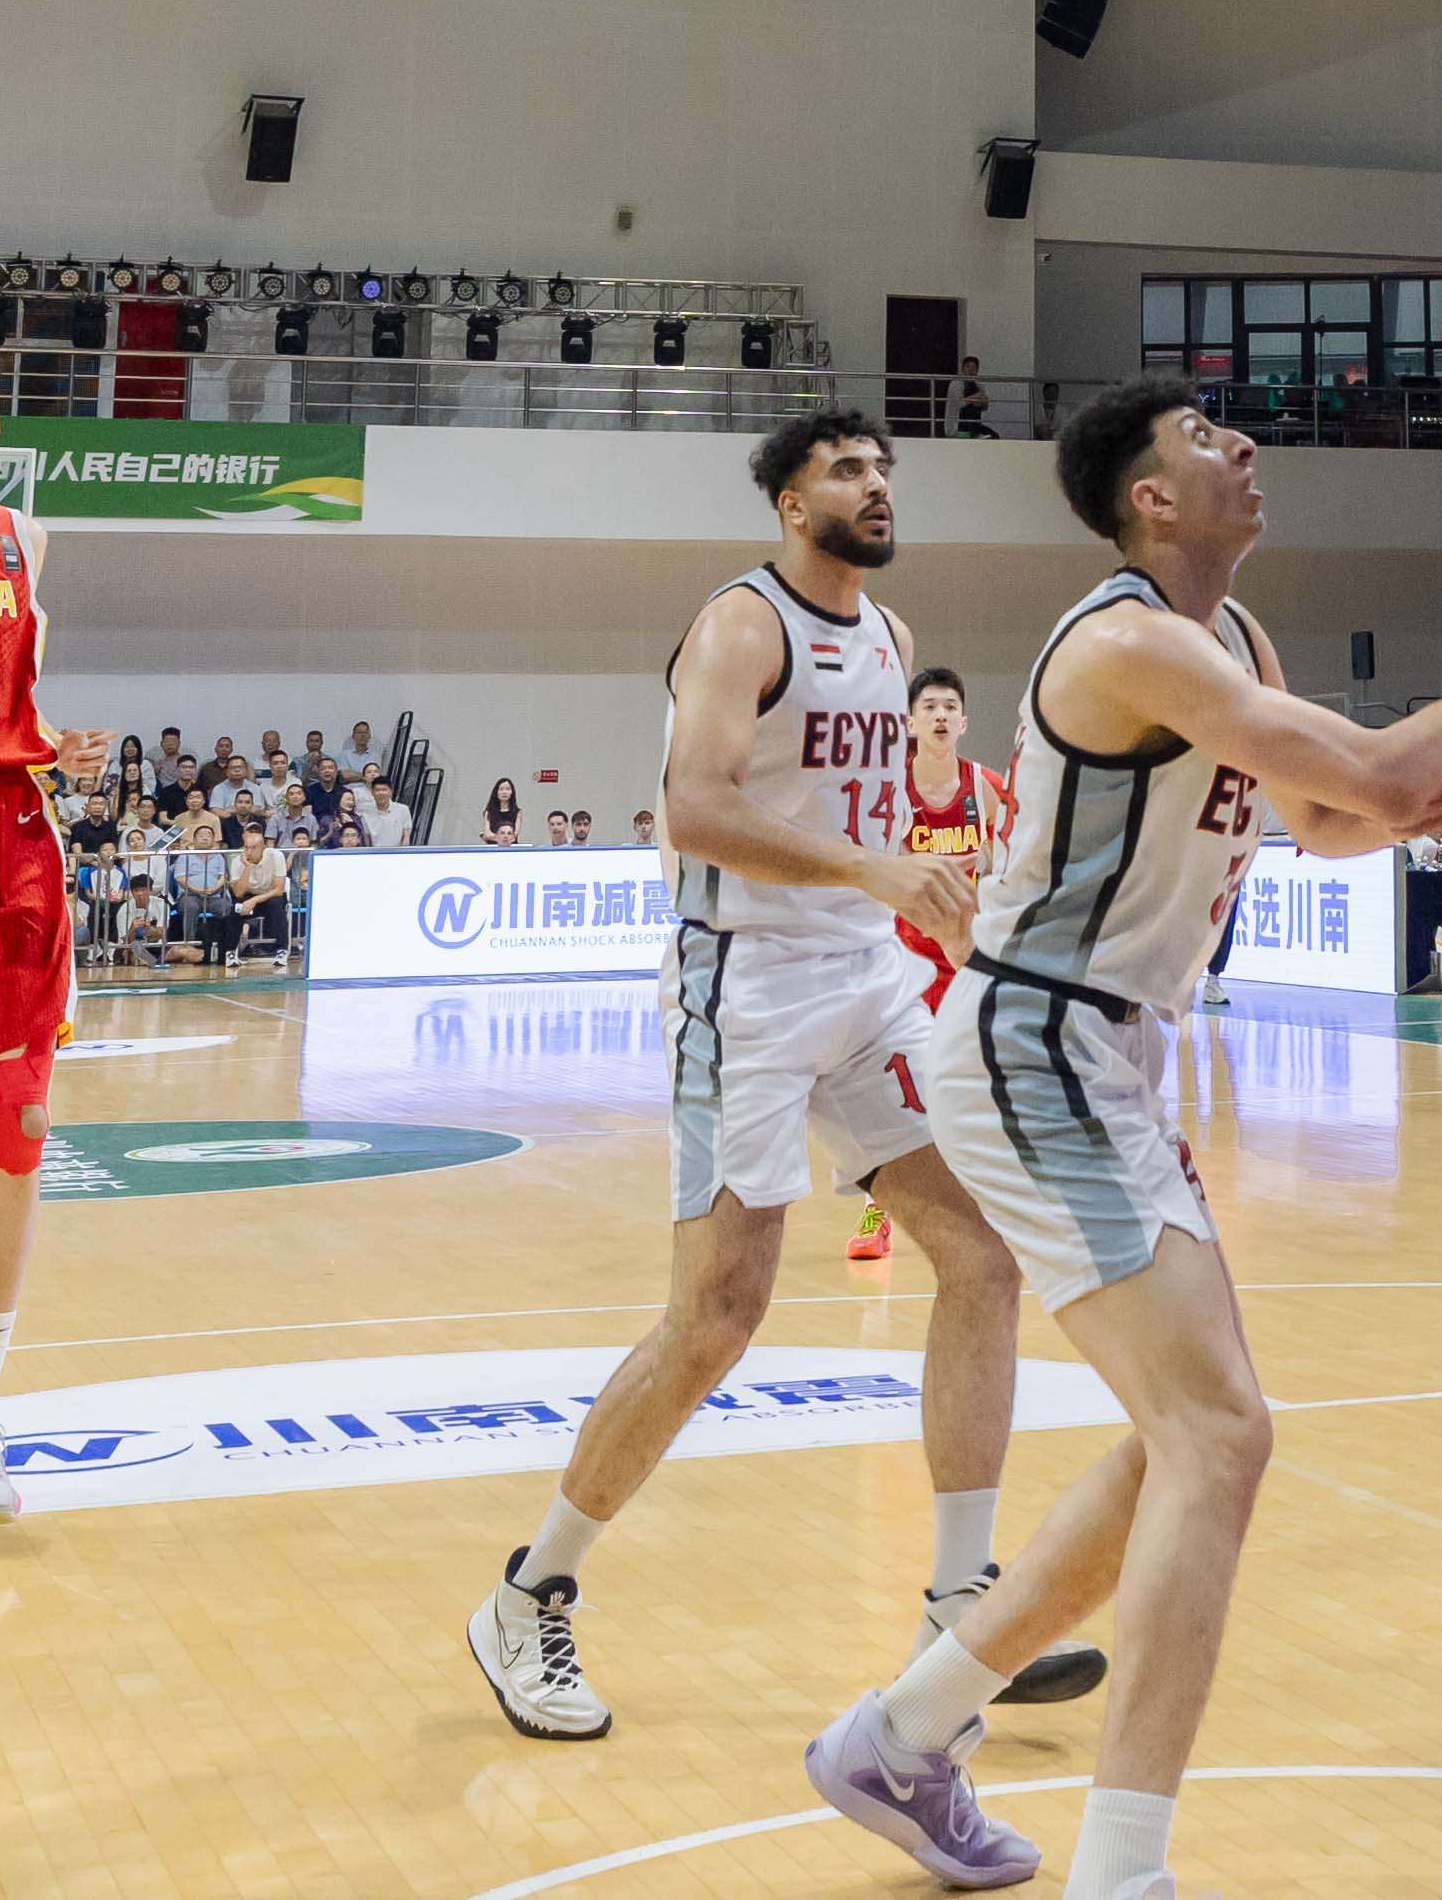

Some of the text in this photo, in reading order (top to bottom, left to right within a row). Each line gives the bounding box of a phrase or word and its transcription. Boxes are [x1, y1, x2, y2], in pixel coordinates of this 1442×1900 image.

[840, 777, 896, 846] 14
[911, 824, 979, 855] CHINA
[489, 936, 567, 949] CHUANNAN
[570, 934, 616, 948] SHOCK
[223, 1430, 519, 1461] CHUANNAN
